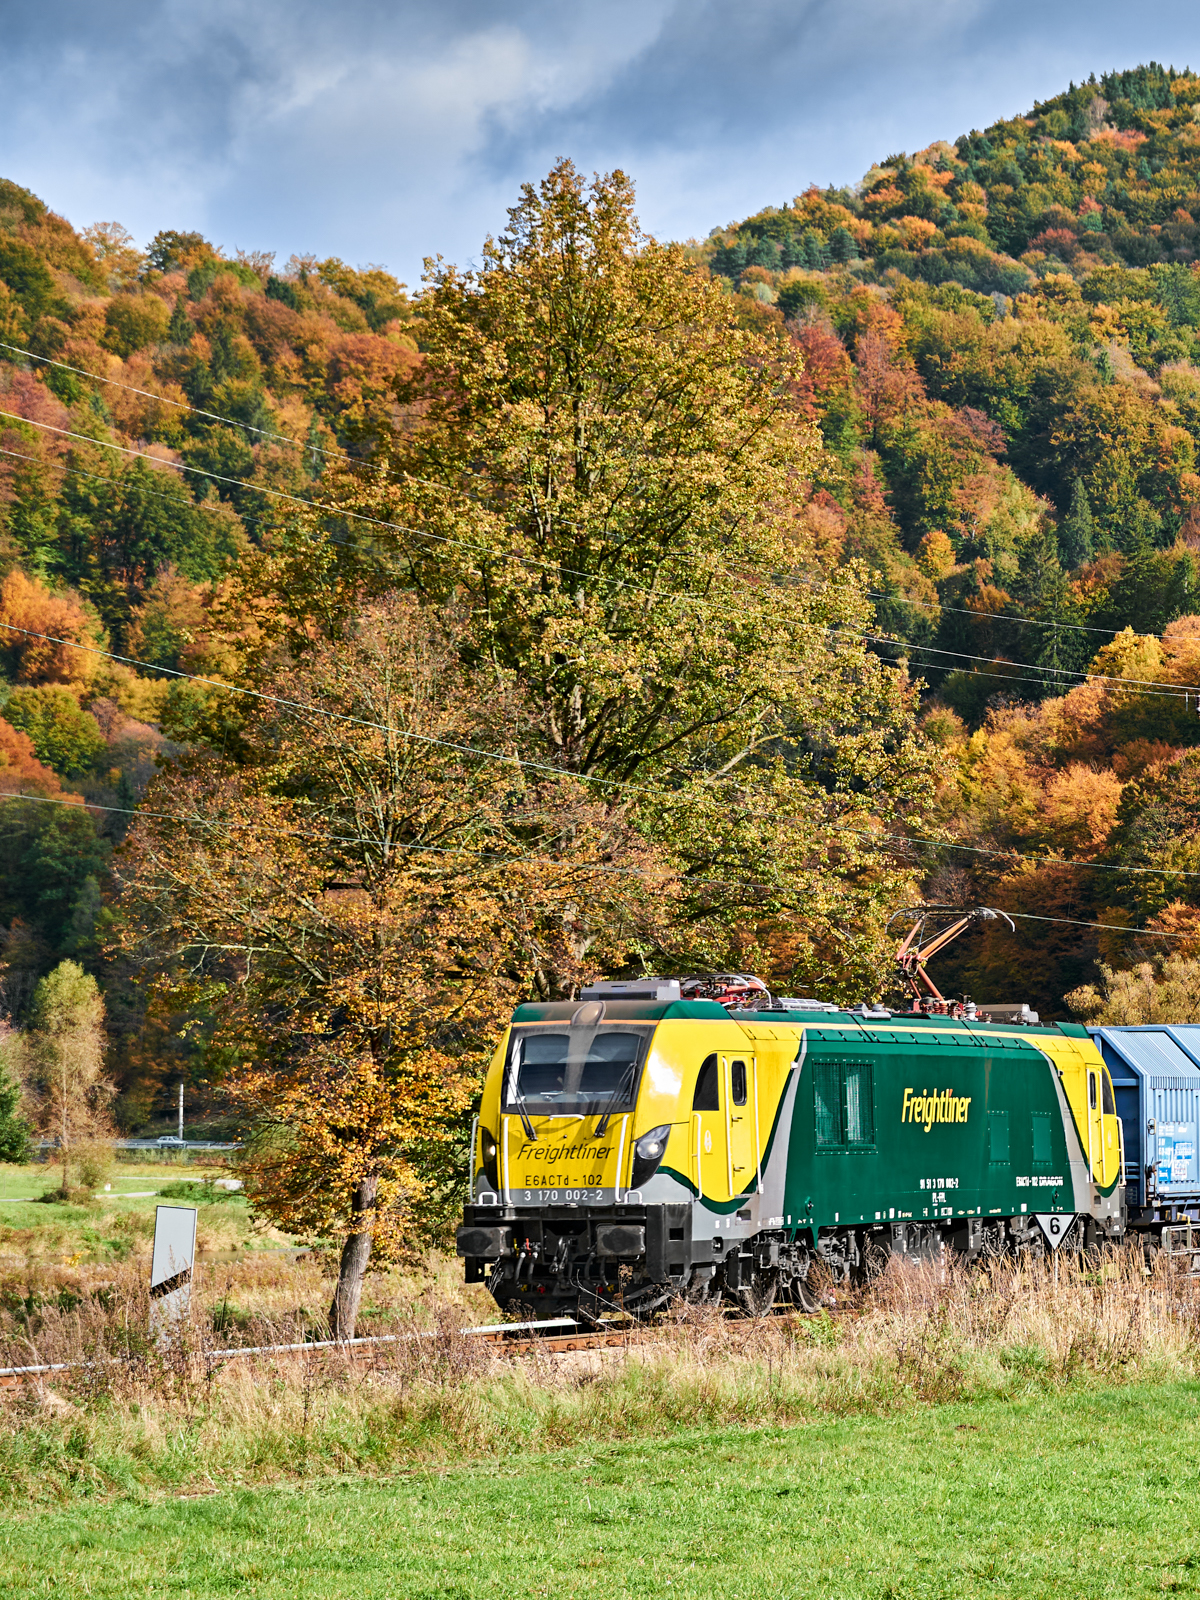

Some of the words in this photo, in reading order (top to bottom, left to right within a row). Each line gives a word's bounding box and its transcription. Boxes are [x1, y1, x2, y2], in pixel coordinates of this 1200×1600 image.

[901, 1087, 972, 1133] Freightliner
[517, 1144, 615, 1164] Freightliner
[525, 1175, 569, 1186] E6ACTd
[582, 1174, 602, 1186] 102
[524, 1190, 532, 1201] 3
[538, 1190, 559, 1201] 170
[565, 1189, 603, 1201] 002-2
[1049, 1216, 1061, 1235] 6
